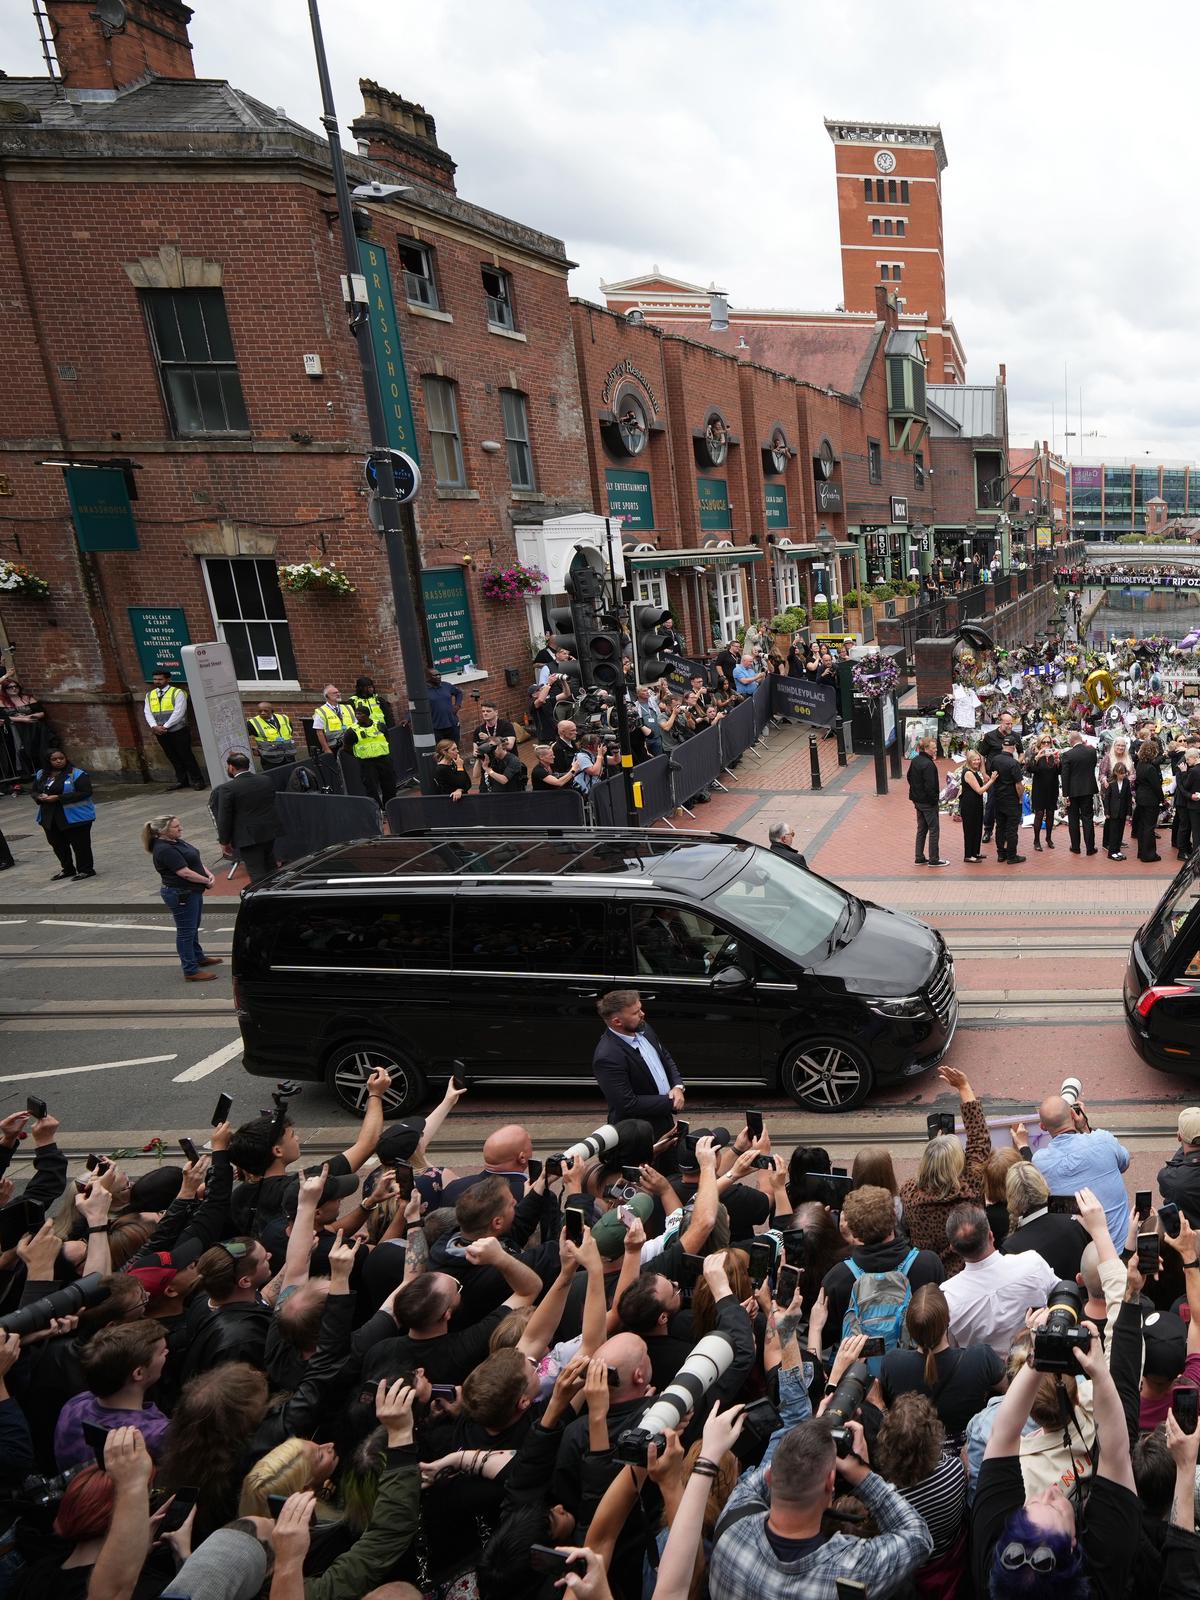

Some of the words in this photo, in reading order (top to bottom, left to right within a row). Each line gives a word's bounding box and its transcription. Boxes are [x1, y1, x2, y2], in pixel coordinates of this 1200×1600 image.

[614, 483, 648, 492] ENTERTAINMENT
[610, 502, 621, 510] LIVE
[622, 502, 639, 510] SPORTS
[895, 503, 906, 516] BOX
[1172, 578, 1186, 586] RIP
[423, 588, 464, 600] RASSHOUSE
[435, 621, 448, 629] GREAT
[434, 634, 465, 644] ENTERTAINMENT
[448, 643, 463, 651] SPORTS
[776, 683, 827, 702] BRINDLEYPLACE
